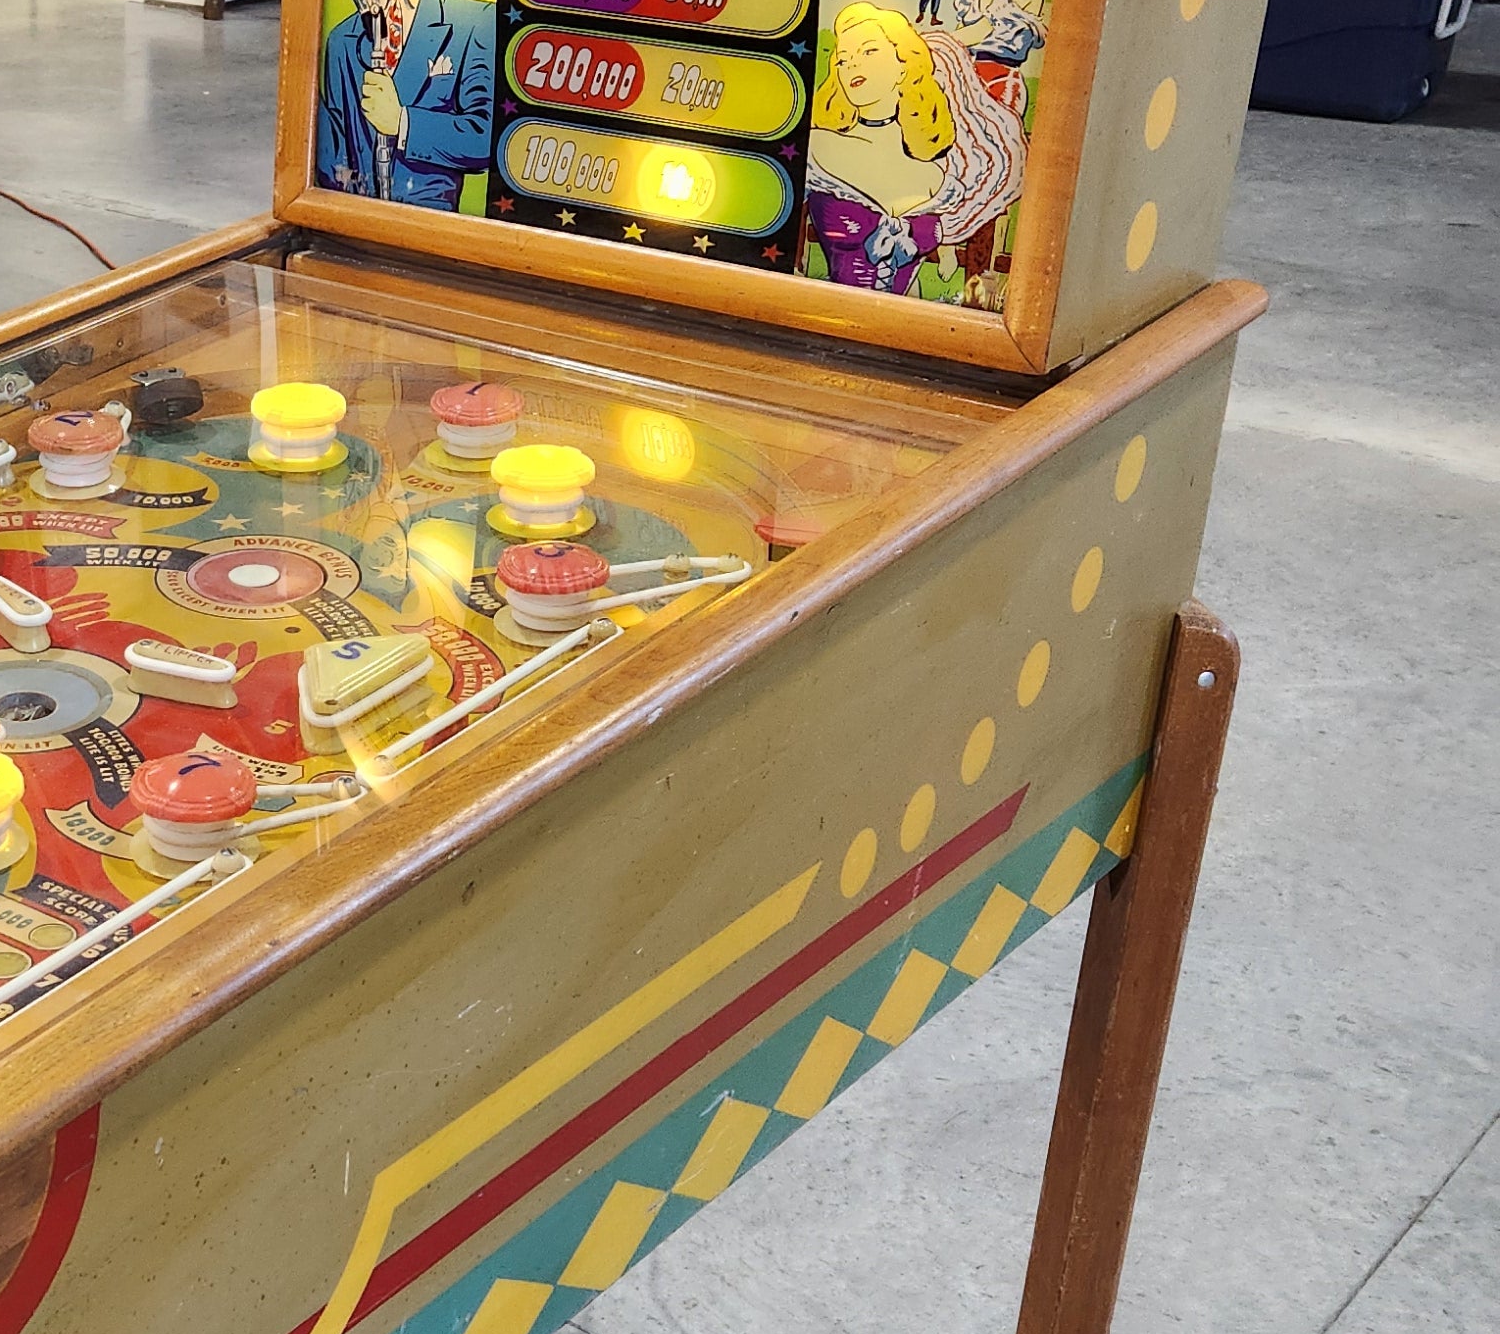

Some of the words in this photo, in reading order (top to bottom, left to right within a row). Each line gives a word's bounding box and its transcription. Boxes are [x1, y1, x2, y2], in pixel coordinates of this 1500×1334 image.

[524, 41, 636, 99] 200,000
[233, 538, 319, 552] ADVANCE
[318, 550, 353, 580] BONUS
[214, 605, 257, 614] WHEN
[79, 737, 101, 758] LITE
[98, 768, 114, 784] LIT
[248, 758, 286, 770] WHEN
[38, 881, 104, 913] SPECIAL
[45, 898, 98, 927] SCORE
